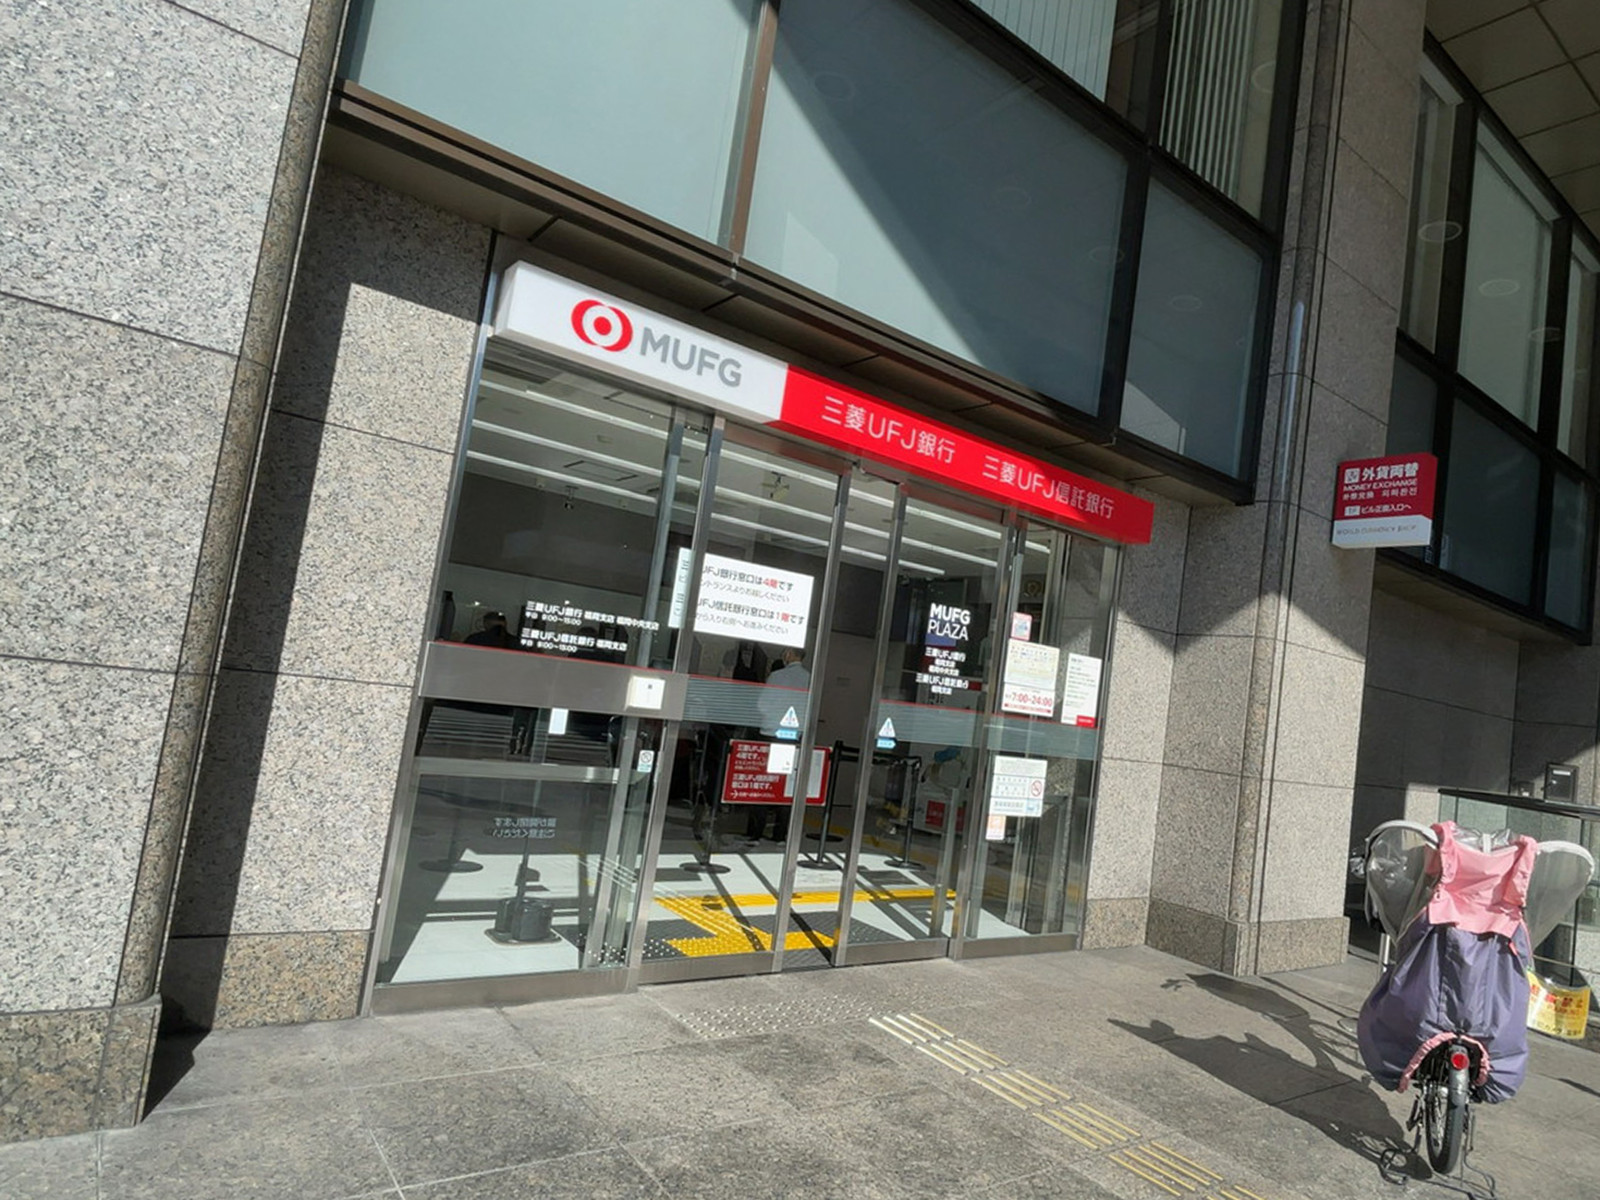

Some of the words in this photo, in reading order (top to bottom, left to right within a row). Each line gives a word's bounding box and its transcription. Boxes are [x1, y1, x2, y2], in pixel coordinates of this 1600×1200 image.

[640, 327, 742, 388] MUFG
[822, 395, 956, 464] 三菱UFJ銀行
[982, 454, 1115, 519] 三菱UFJ信託銀行
[1362, 462, 1419, 481] 外貨両替
[1343, 482, 1372, 492] MONEY
[1373, 478, 1418, 489] EXCHANGE
[525, 600, 583, 619] 三菱UFJ銀行
[929, 602, 971, 625] MUFG
[927, 619, 969, 641] PLAZA
